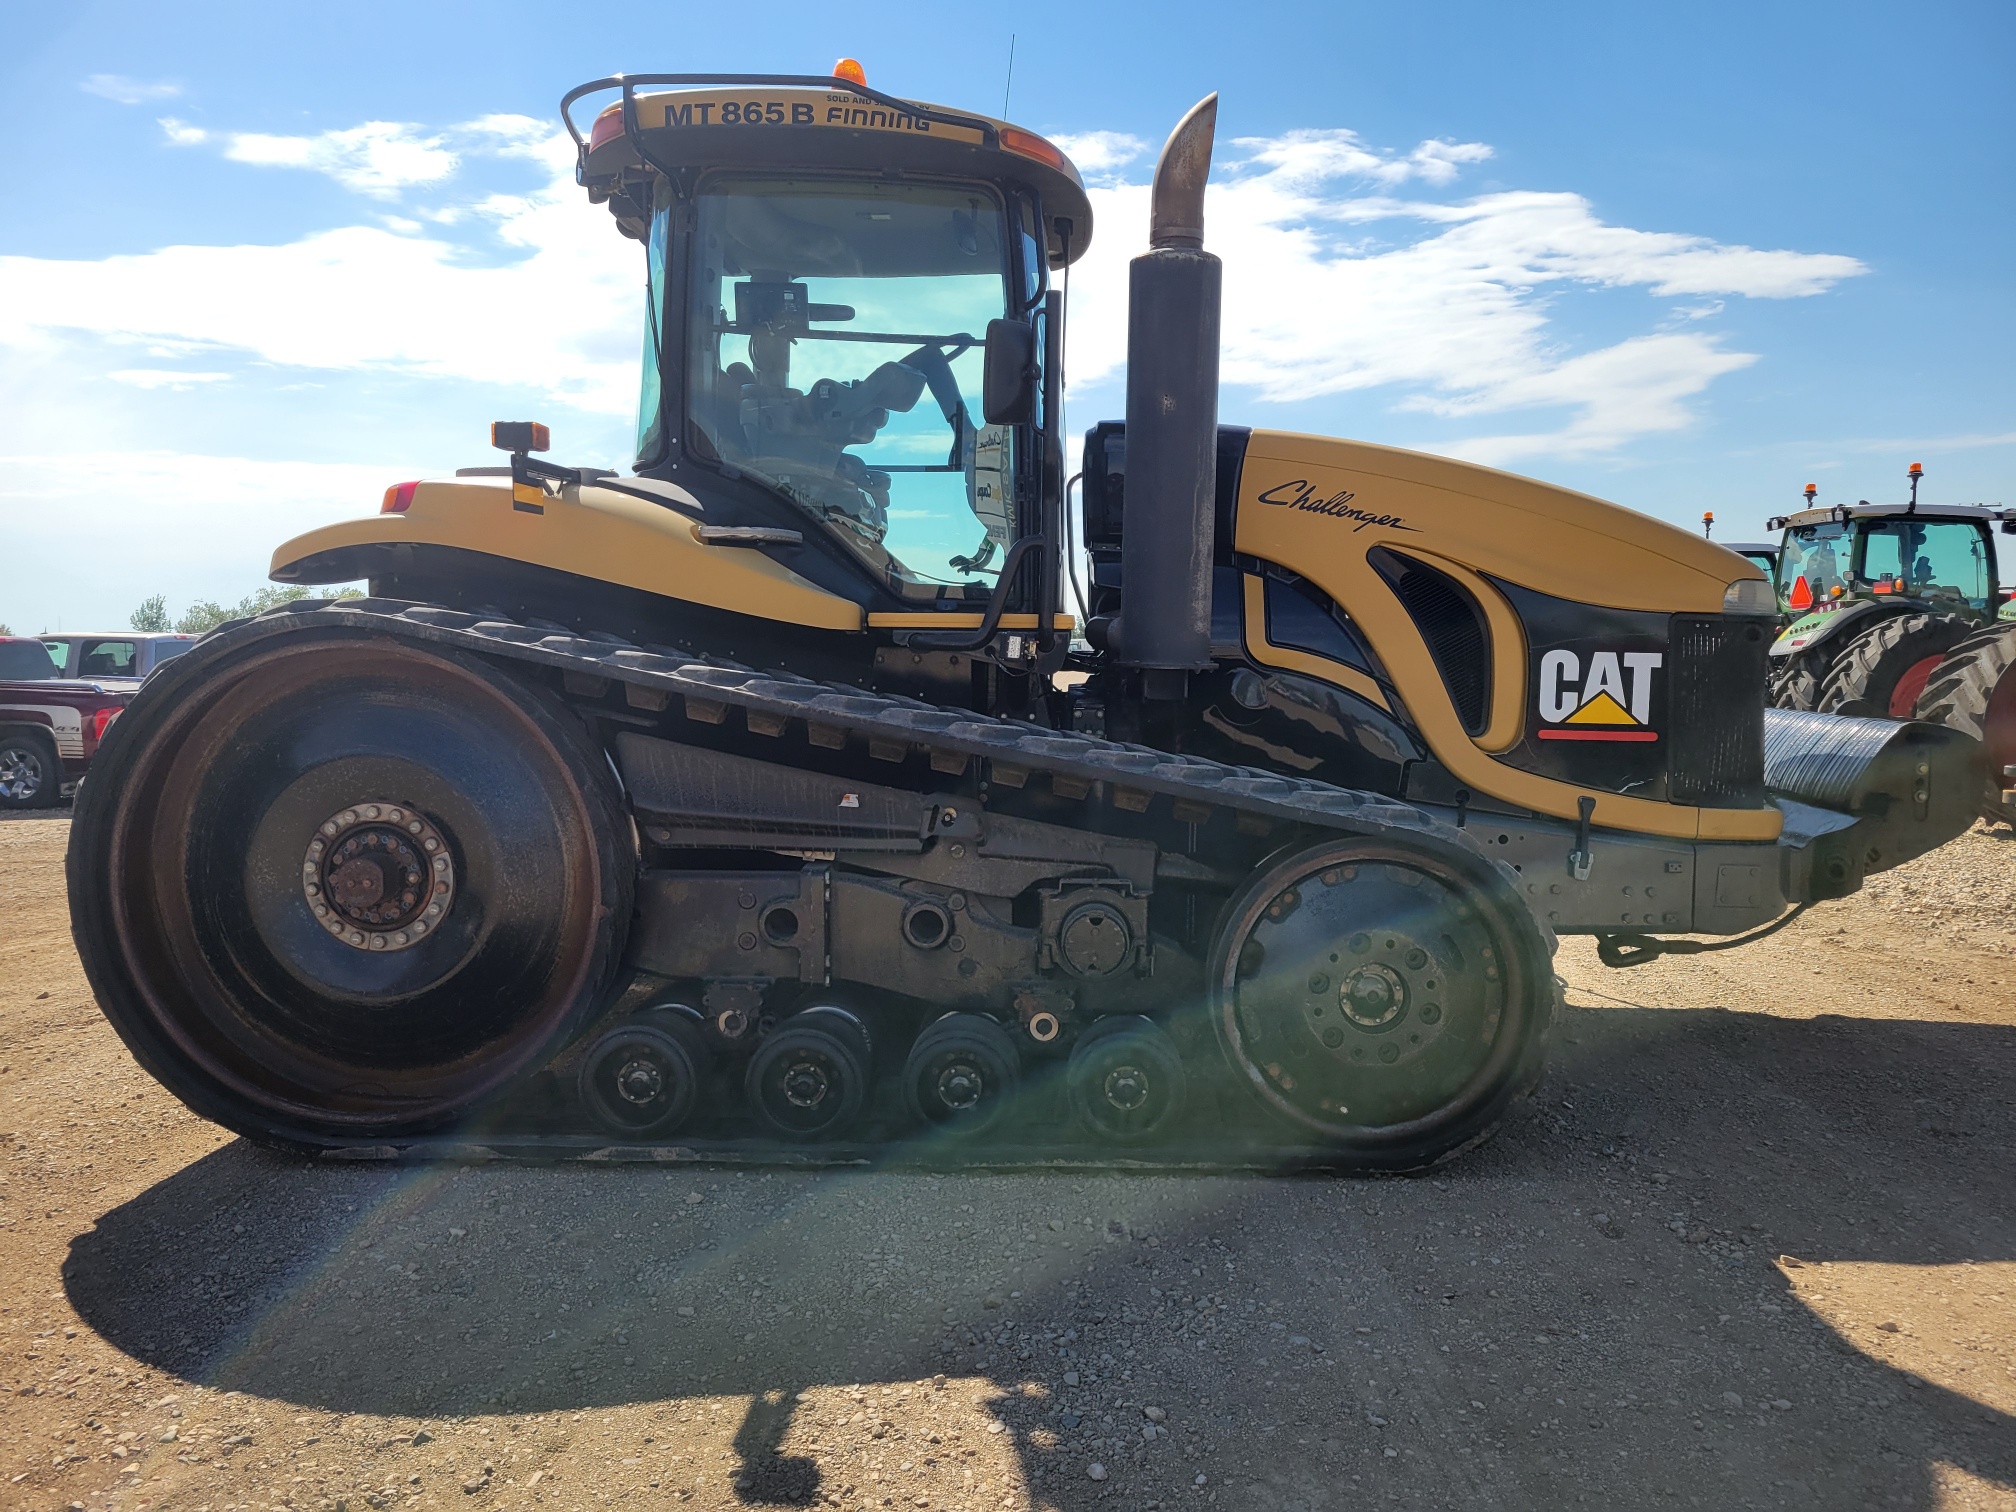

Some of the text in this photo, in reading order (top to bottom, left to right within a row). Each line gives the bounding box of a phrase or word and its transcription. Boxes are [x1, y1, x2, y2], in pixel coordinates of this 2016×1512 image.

[826, 94, 850, 103] SOLD
[852, 97, 872, 105] AND
[1258, 479, 1425, 533] Challenger
[1539, 649, 1663, 725] CAT
